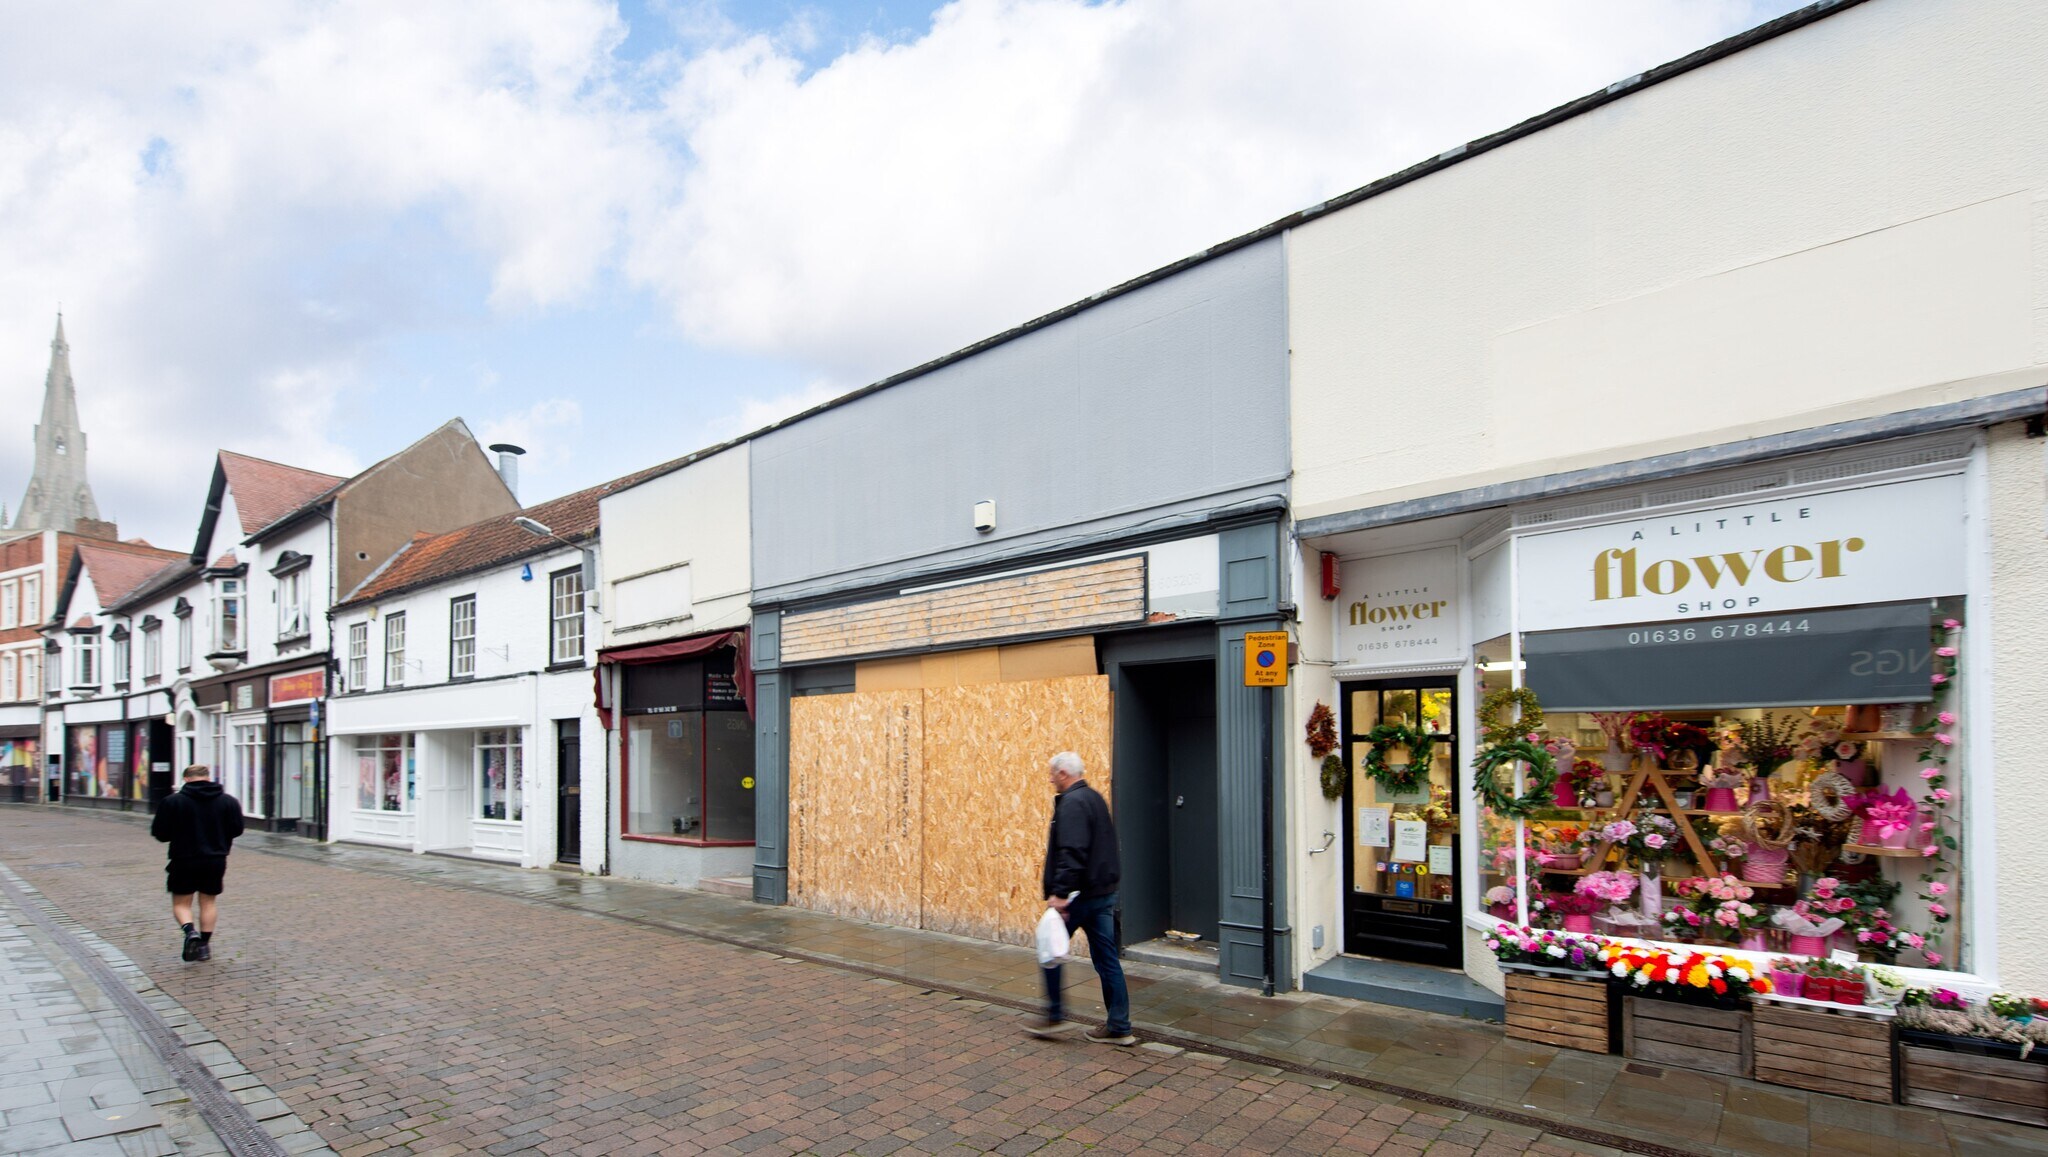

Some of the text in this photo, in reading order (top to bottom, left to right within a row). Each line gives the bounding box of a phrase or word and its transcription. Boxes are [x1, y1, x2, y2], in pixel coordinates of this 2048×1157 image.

[1631, 508, 1811, 541] A LITTLE
[1590, 536, 1866, 602] flower
[1377, 587, 1428, 598] LITTLE
[1349, 600, 1447, 626] flower
[1677, 596, 1761, 614] SHOP
[1381, 624, 1412, 632] SHOP
[1628, 619, 1811, 645] 01636 678444
[1356, 638, 1438, 651] 01636 678444
[1421, 903, 1433, 915] 17
